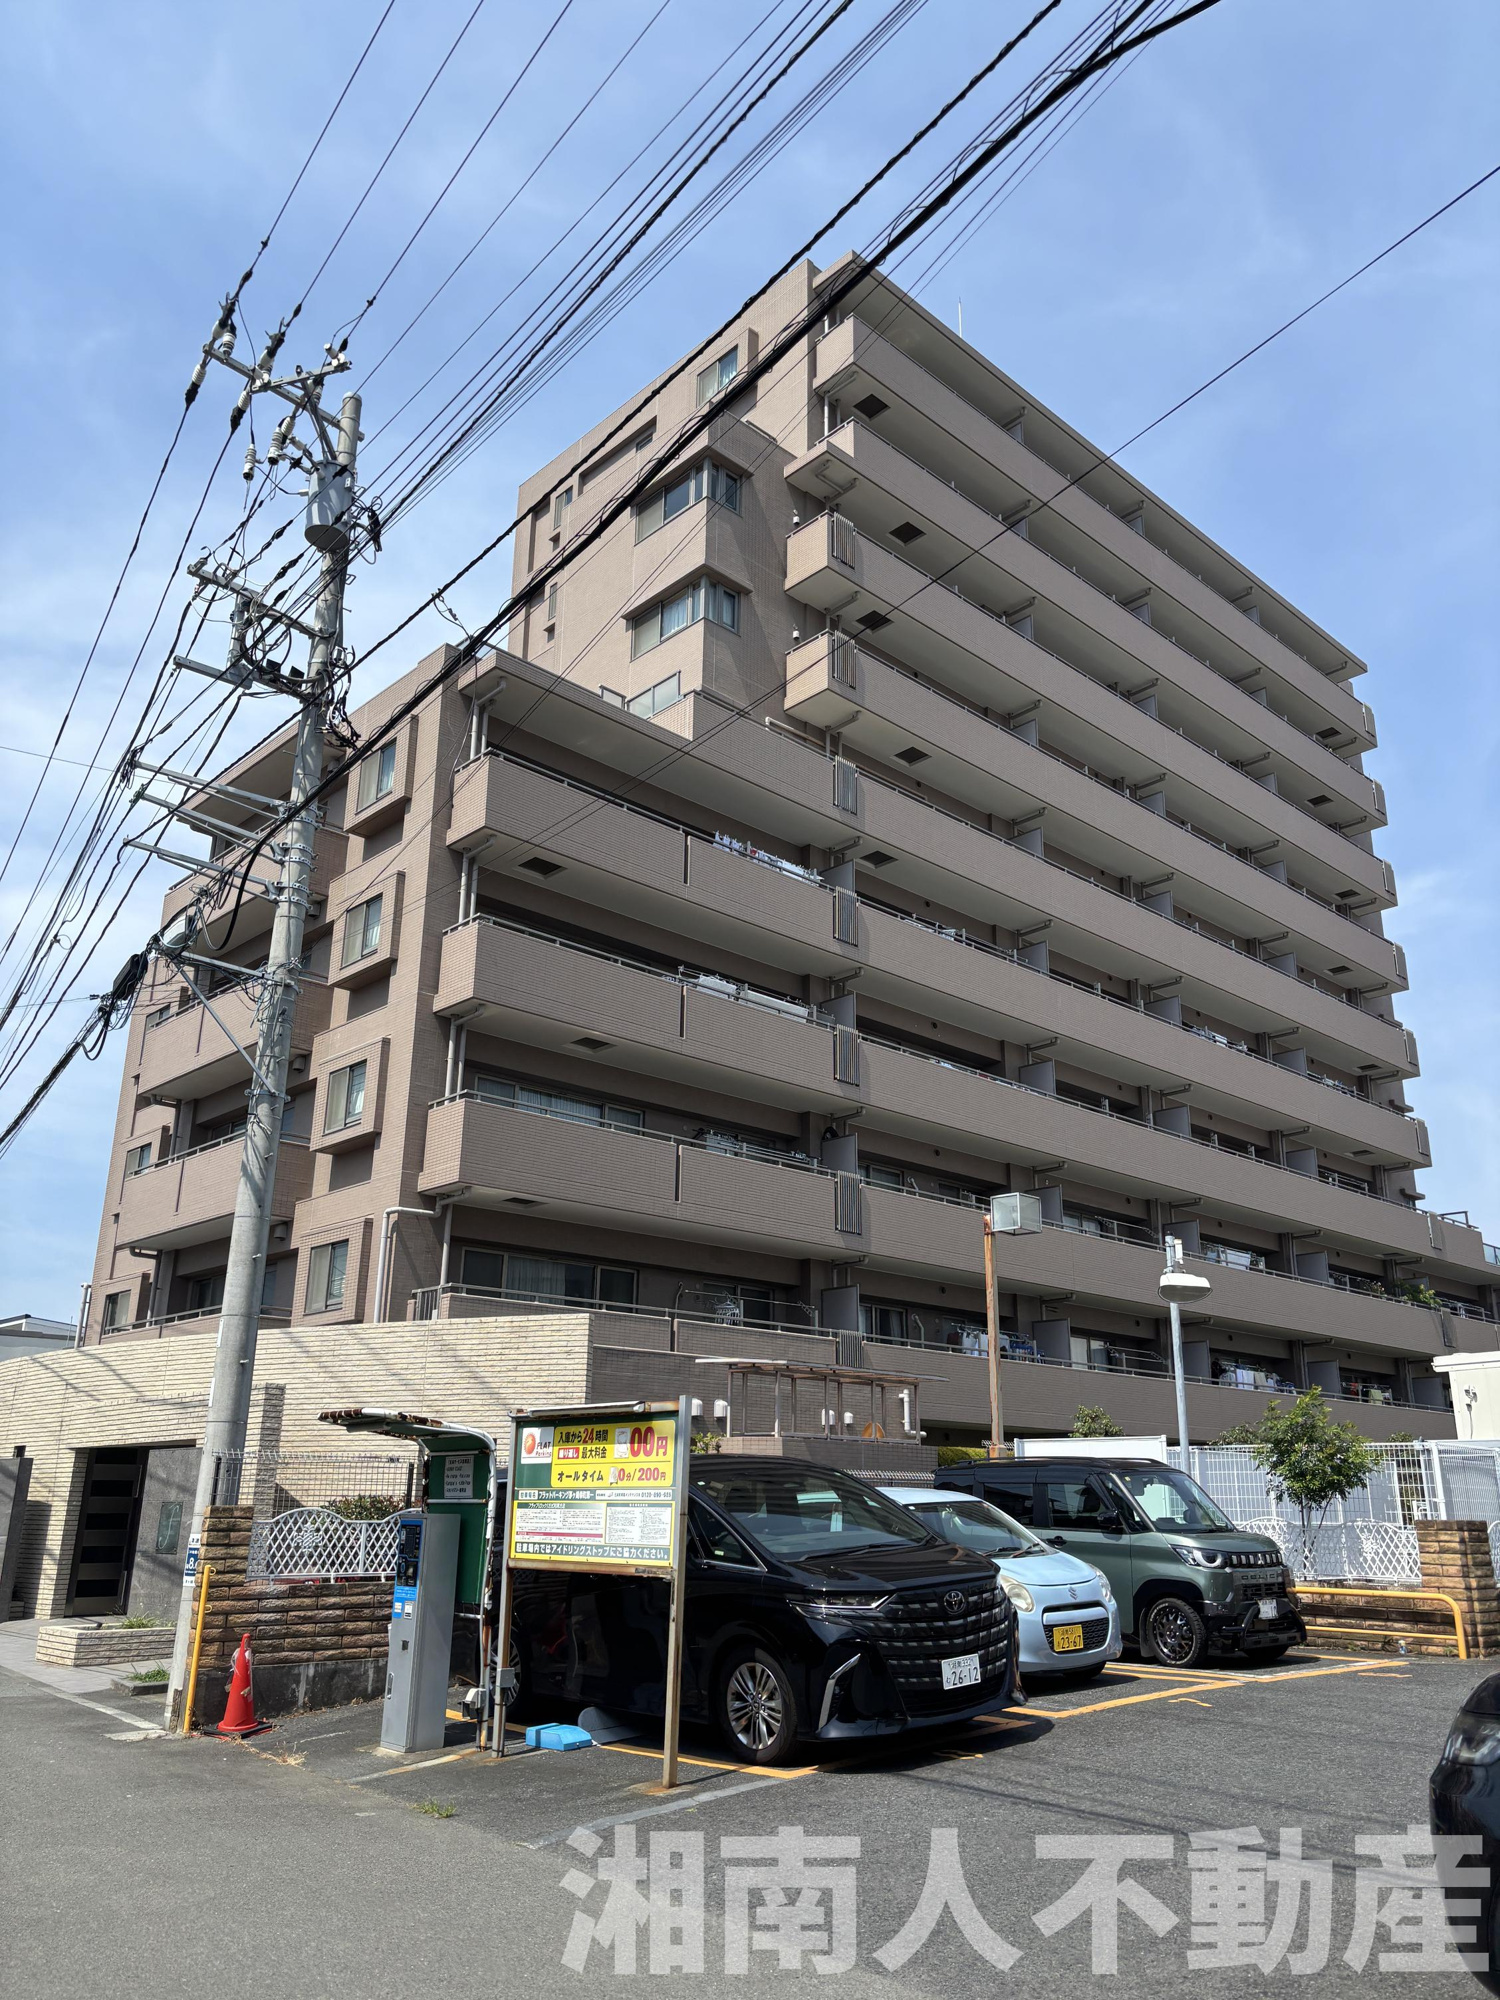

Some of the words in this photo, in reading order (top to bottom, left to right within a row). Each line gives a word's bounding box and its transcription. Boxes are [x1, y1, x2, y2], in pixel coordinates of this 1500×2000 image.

[557, 1427, 609, 1444] 入庫から24時間
[616, 1426, 668, 1458] 00円
[536, 1441, 552, 1450] FLAT
[581, 1447, 607, 1459] 最大料金
[557, 1470, 604, 1482] オールタイム
[611, 1467, 666, 1483] 0分/200円
[516, 1542, 668, 1559] 駐車場内ではアイドリングストップにご協力ください。
[1060, 1634, 1082, 1649] 23-67
[951, 1666, 980, 1686] 26-12
